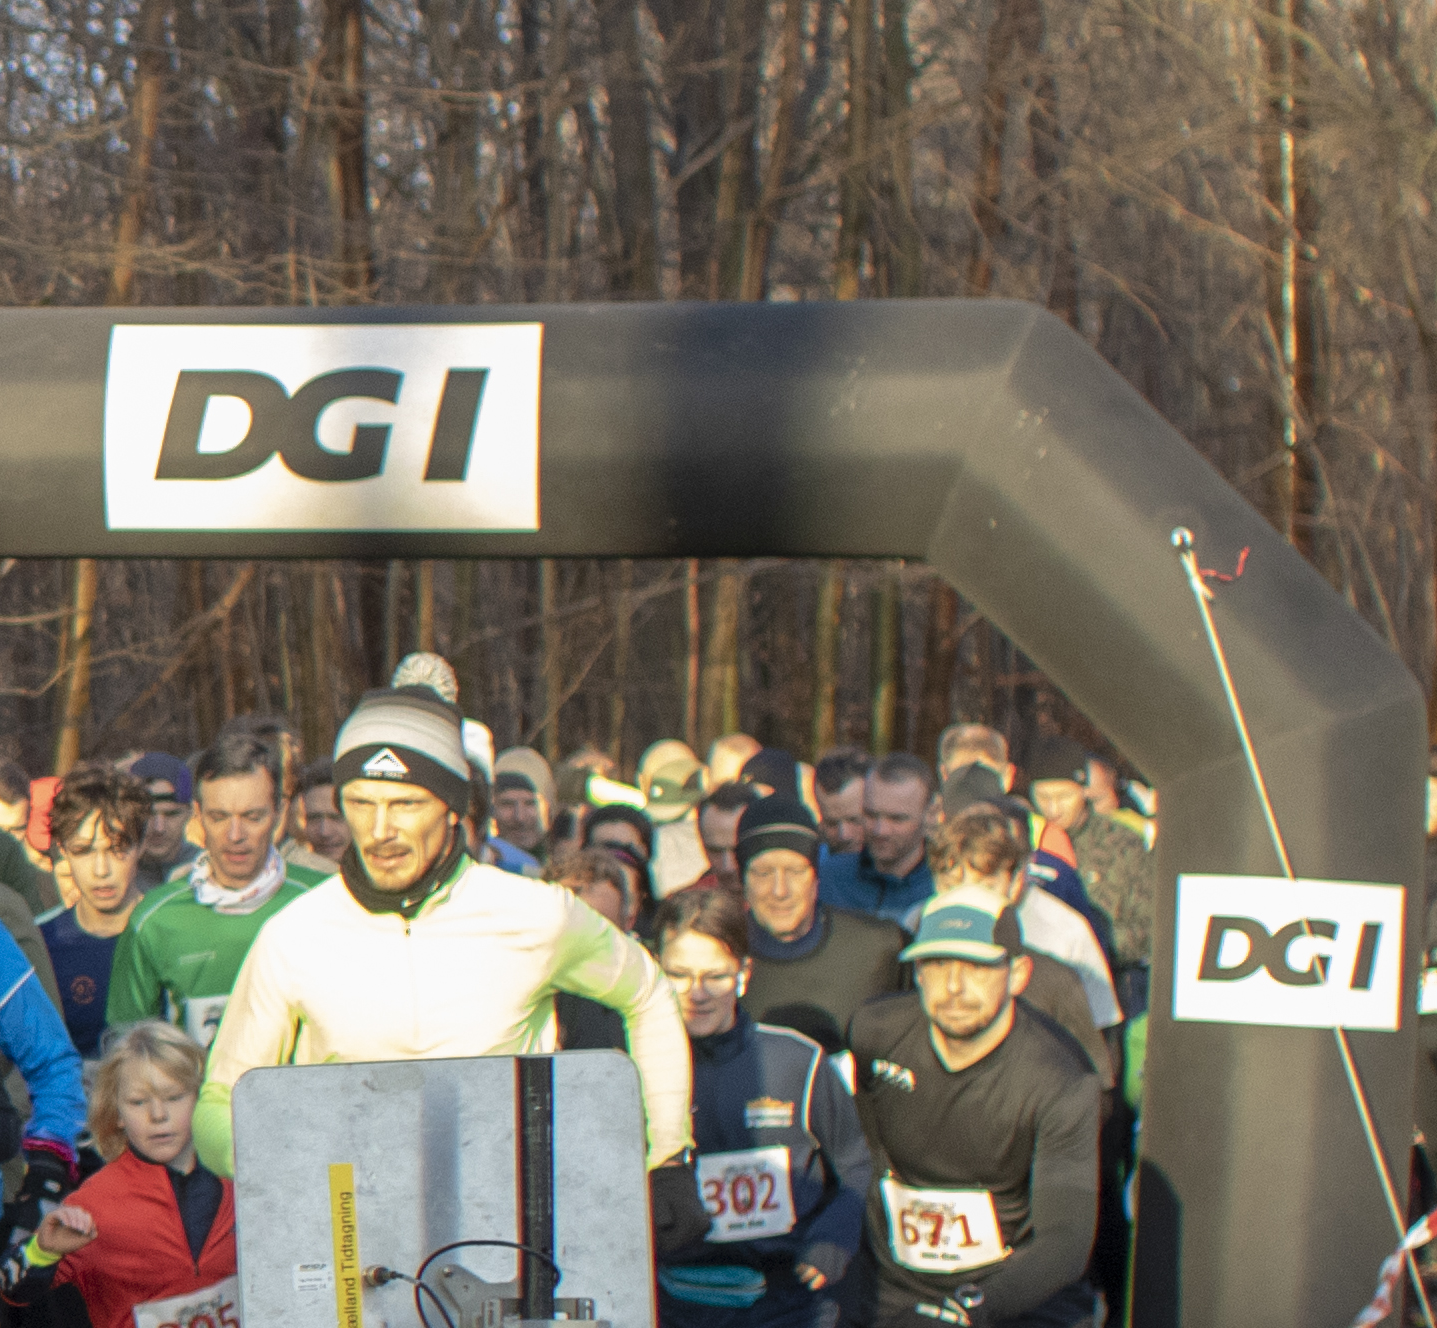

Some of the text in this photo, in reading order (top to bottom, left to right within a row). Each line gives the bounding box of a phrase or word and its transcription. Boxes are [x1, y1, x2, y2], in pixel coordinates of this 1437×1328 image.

[154, 366, 490, 484] DGI
[1197, 914, 1384, 991] DGI
[338, 1191, 355, 1273] Tidtagning
[703, 1171, 780, 1217] 302
[900, 1208, 982, 1248] 671
